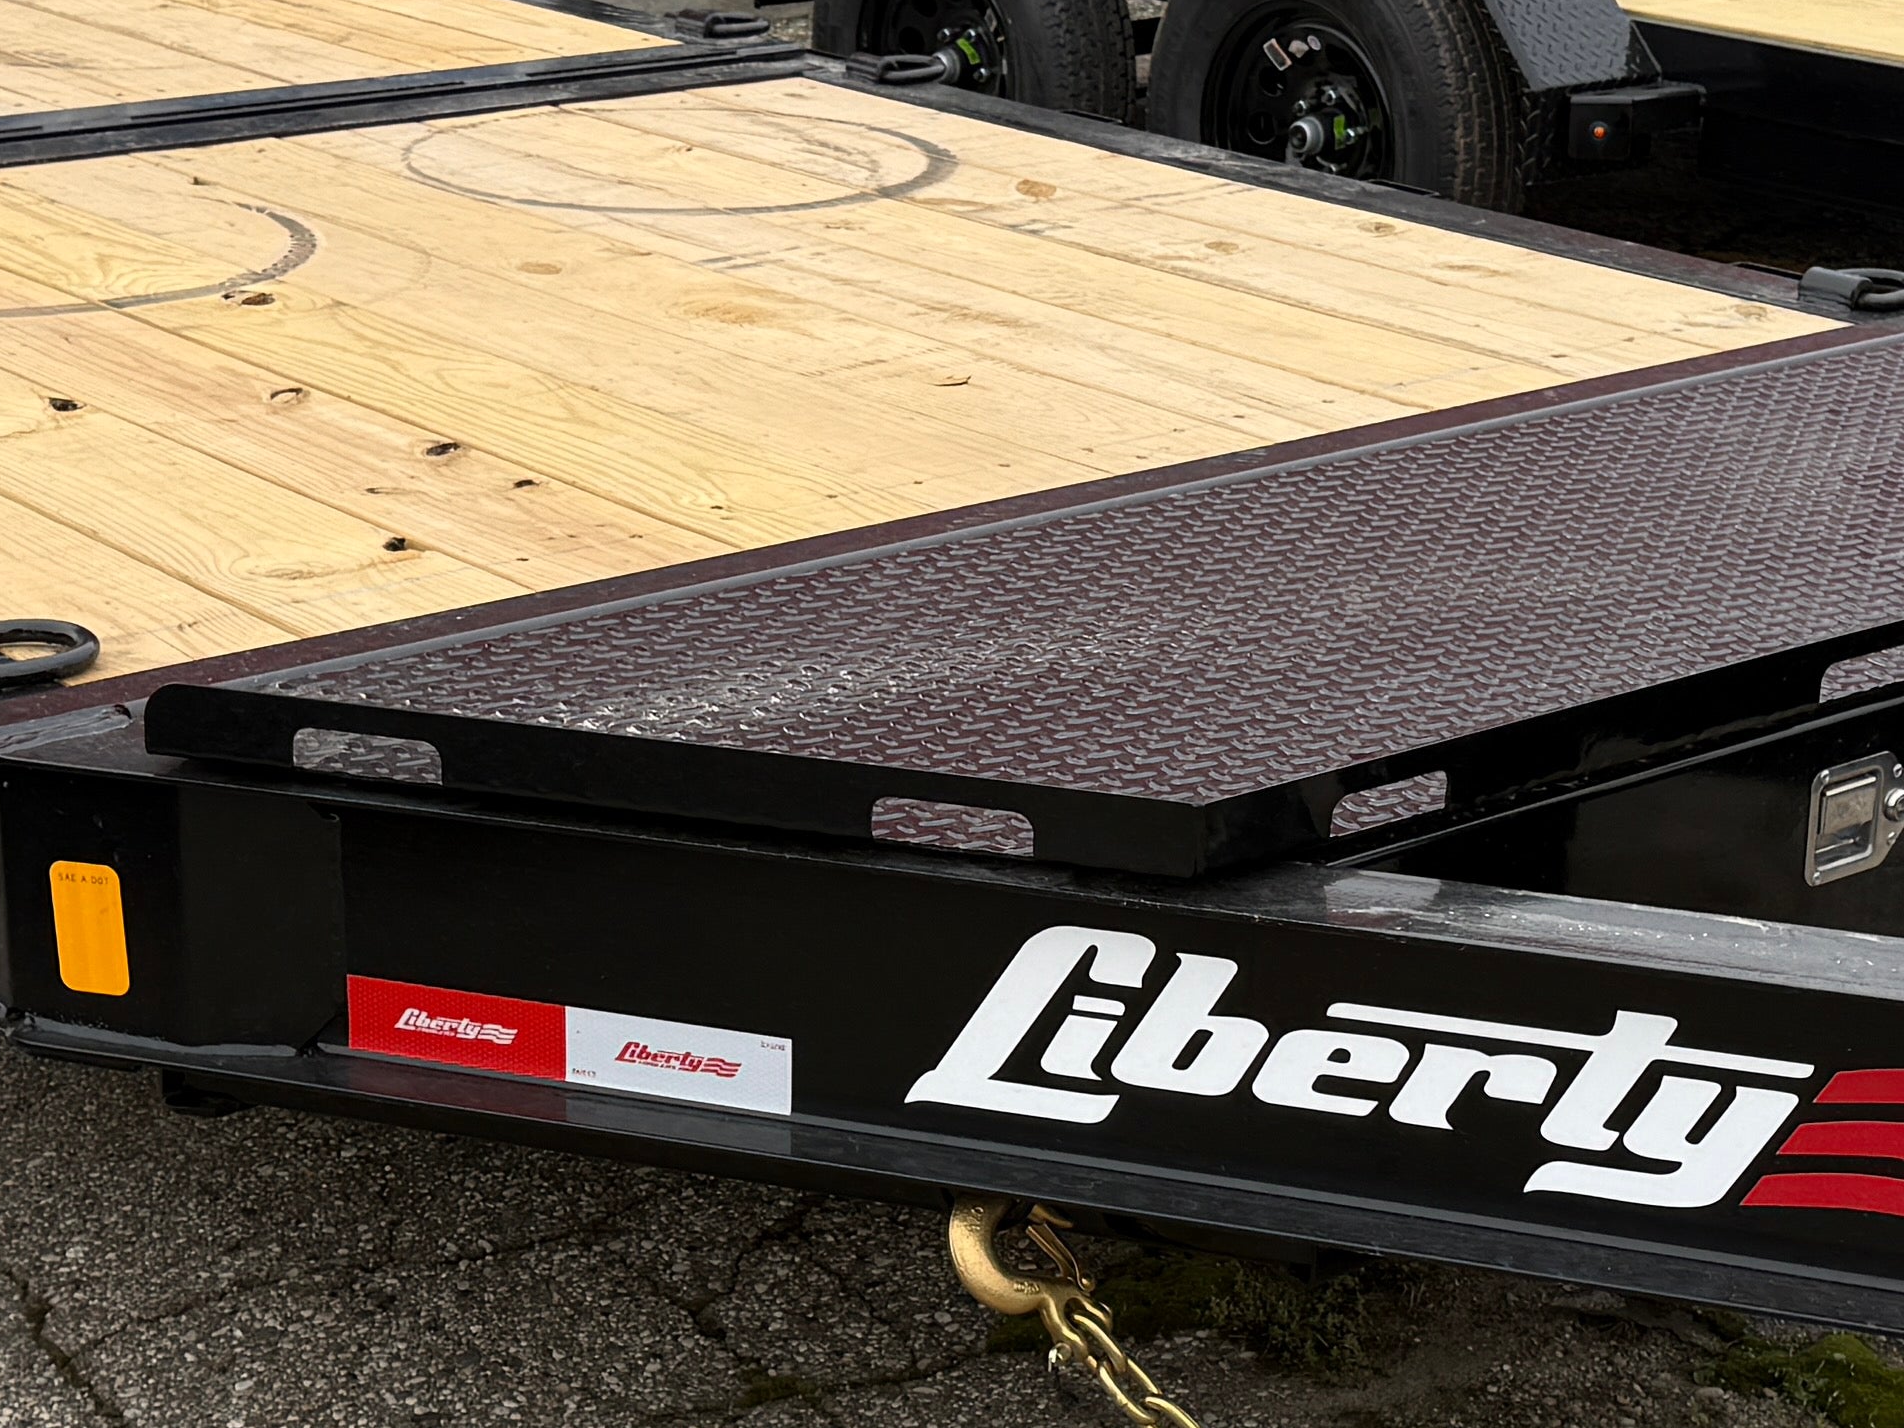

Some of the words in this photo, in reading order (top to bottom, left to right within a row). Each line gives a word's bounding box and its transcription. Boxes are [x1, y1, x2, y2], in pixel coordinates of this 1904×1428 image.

[58, 873, 77, 883] SAE
[394, 1007, 482, 1040] Liberty
[615, 1041, 705, 1073] Liberty
[905, 925, 1815, 1208] Liberty
